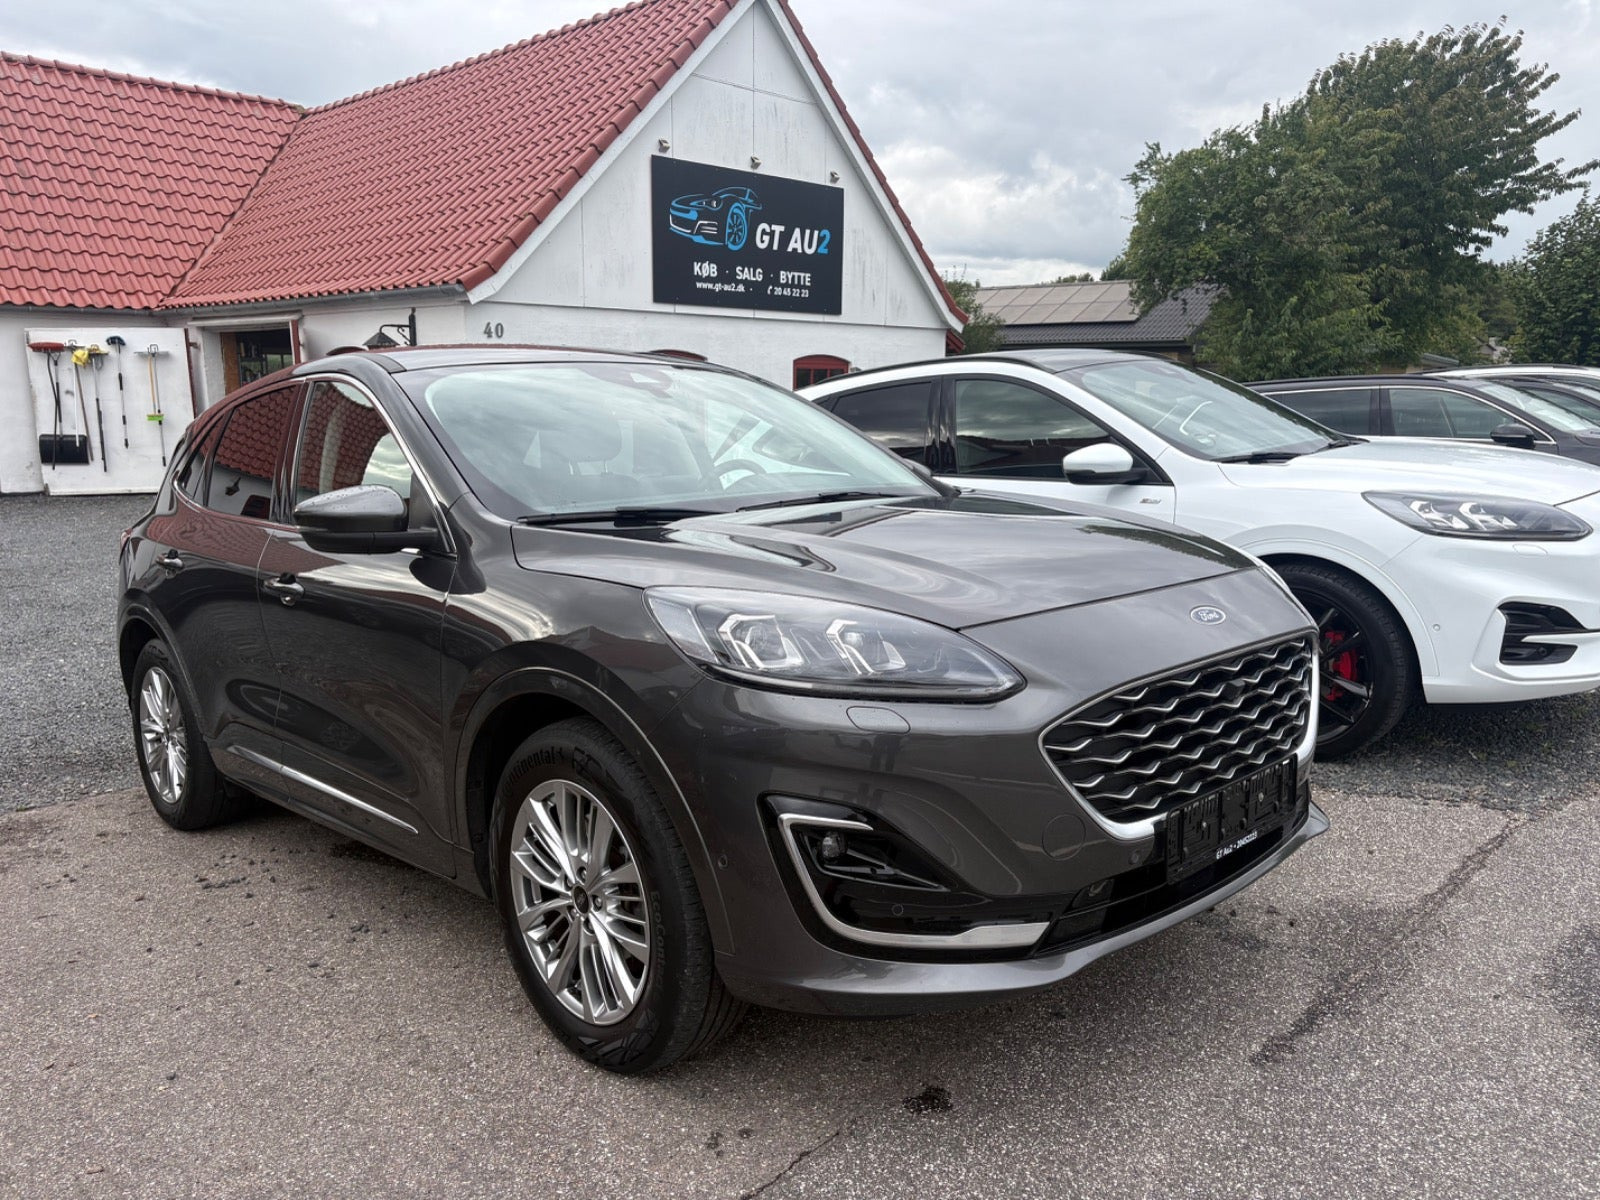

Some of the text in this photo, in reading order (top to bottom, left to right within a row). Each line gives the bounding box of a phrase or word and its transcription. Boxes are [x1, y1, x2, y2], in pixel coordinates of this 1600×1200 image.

[755, 222, 831, 255] GT AU2
[693, 261, 811, 286] KØB SALG BYTTE
[696, 281, 745, 292] www.gt-au2.dk
[483, 321, 504, 338] 40
